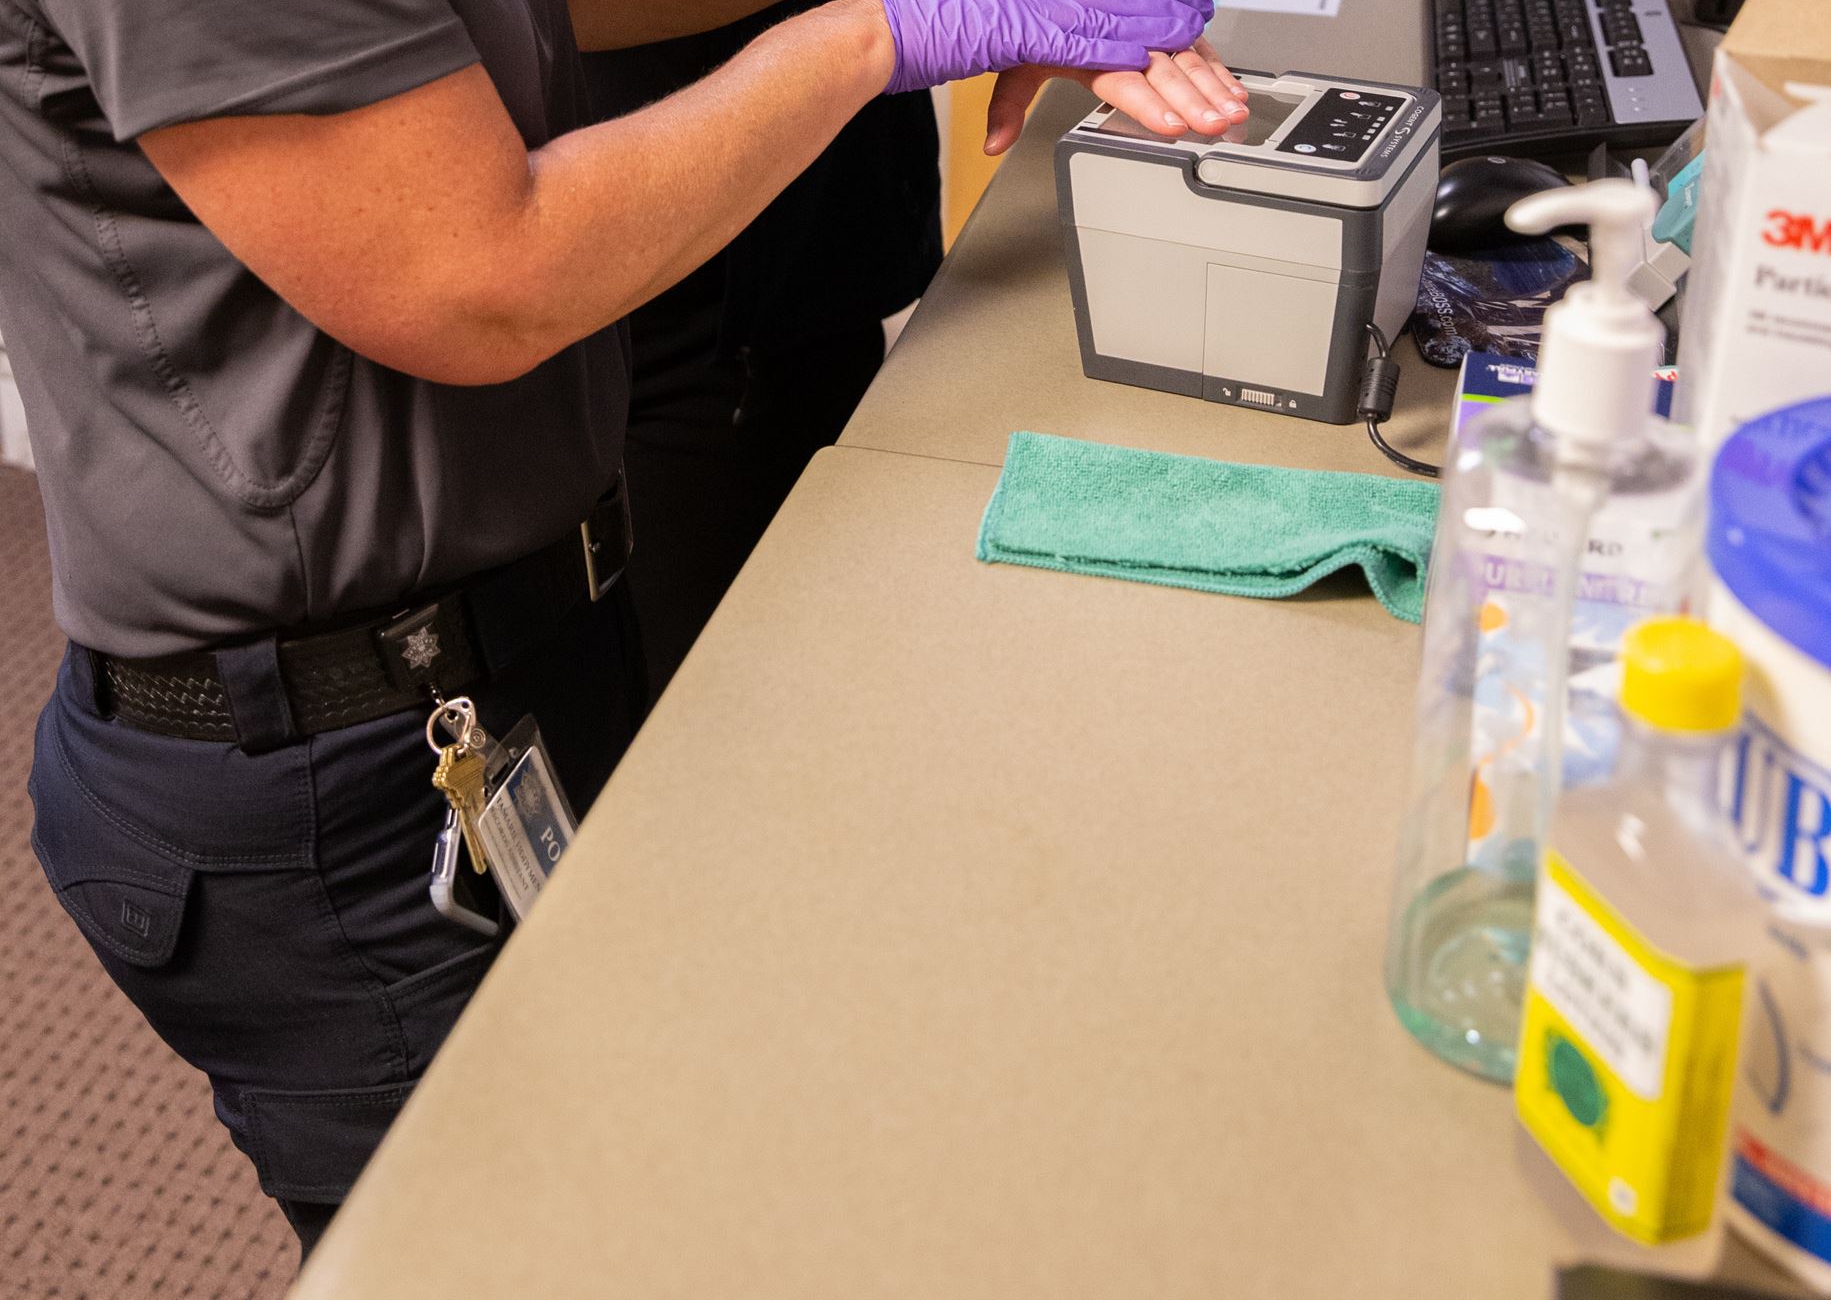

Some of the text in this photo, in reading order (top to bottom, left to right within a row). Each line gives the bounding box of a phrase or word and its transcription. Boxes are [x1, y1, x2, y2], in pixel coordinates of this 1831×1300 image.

[1380, 106, 1425, 158] COGENT SYSTEMS
[1762, 209, 1831, 255] 3M
